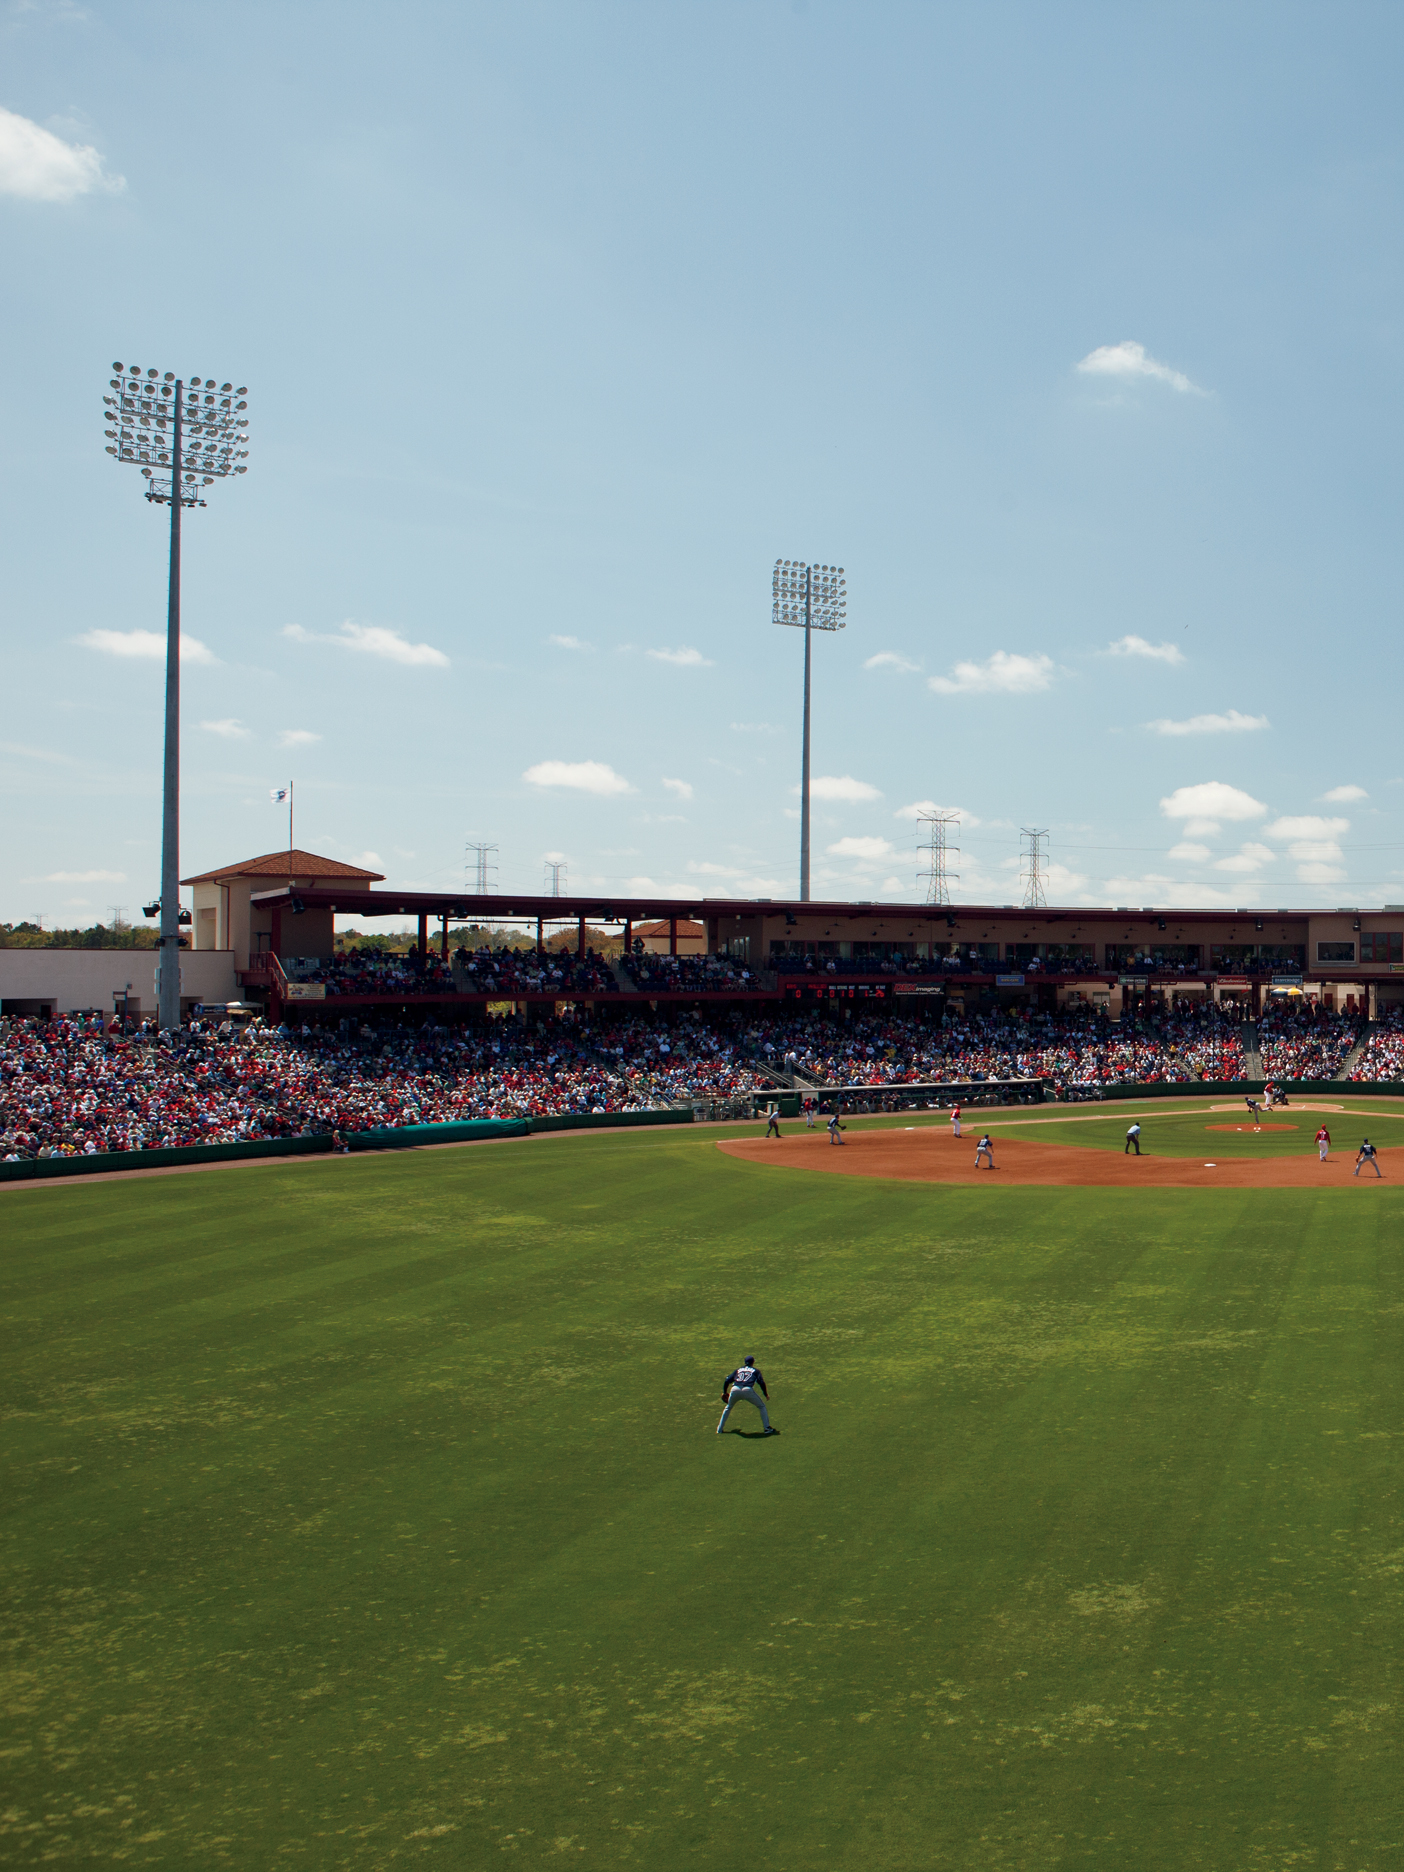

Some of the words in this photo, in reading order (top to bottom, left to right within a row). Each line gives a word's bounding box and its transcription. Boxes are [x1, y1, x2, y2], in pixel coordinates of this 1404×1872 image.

[796, 989, 801, 998] 0
[817, 989, 822, 998] 0
[829, 989, 835, 998] 0
[849, 989, 854, 998] 0
